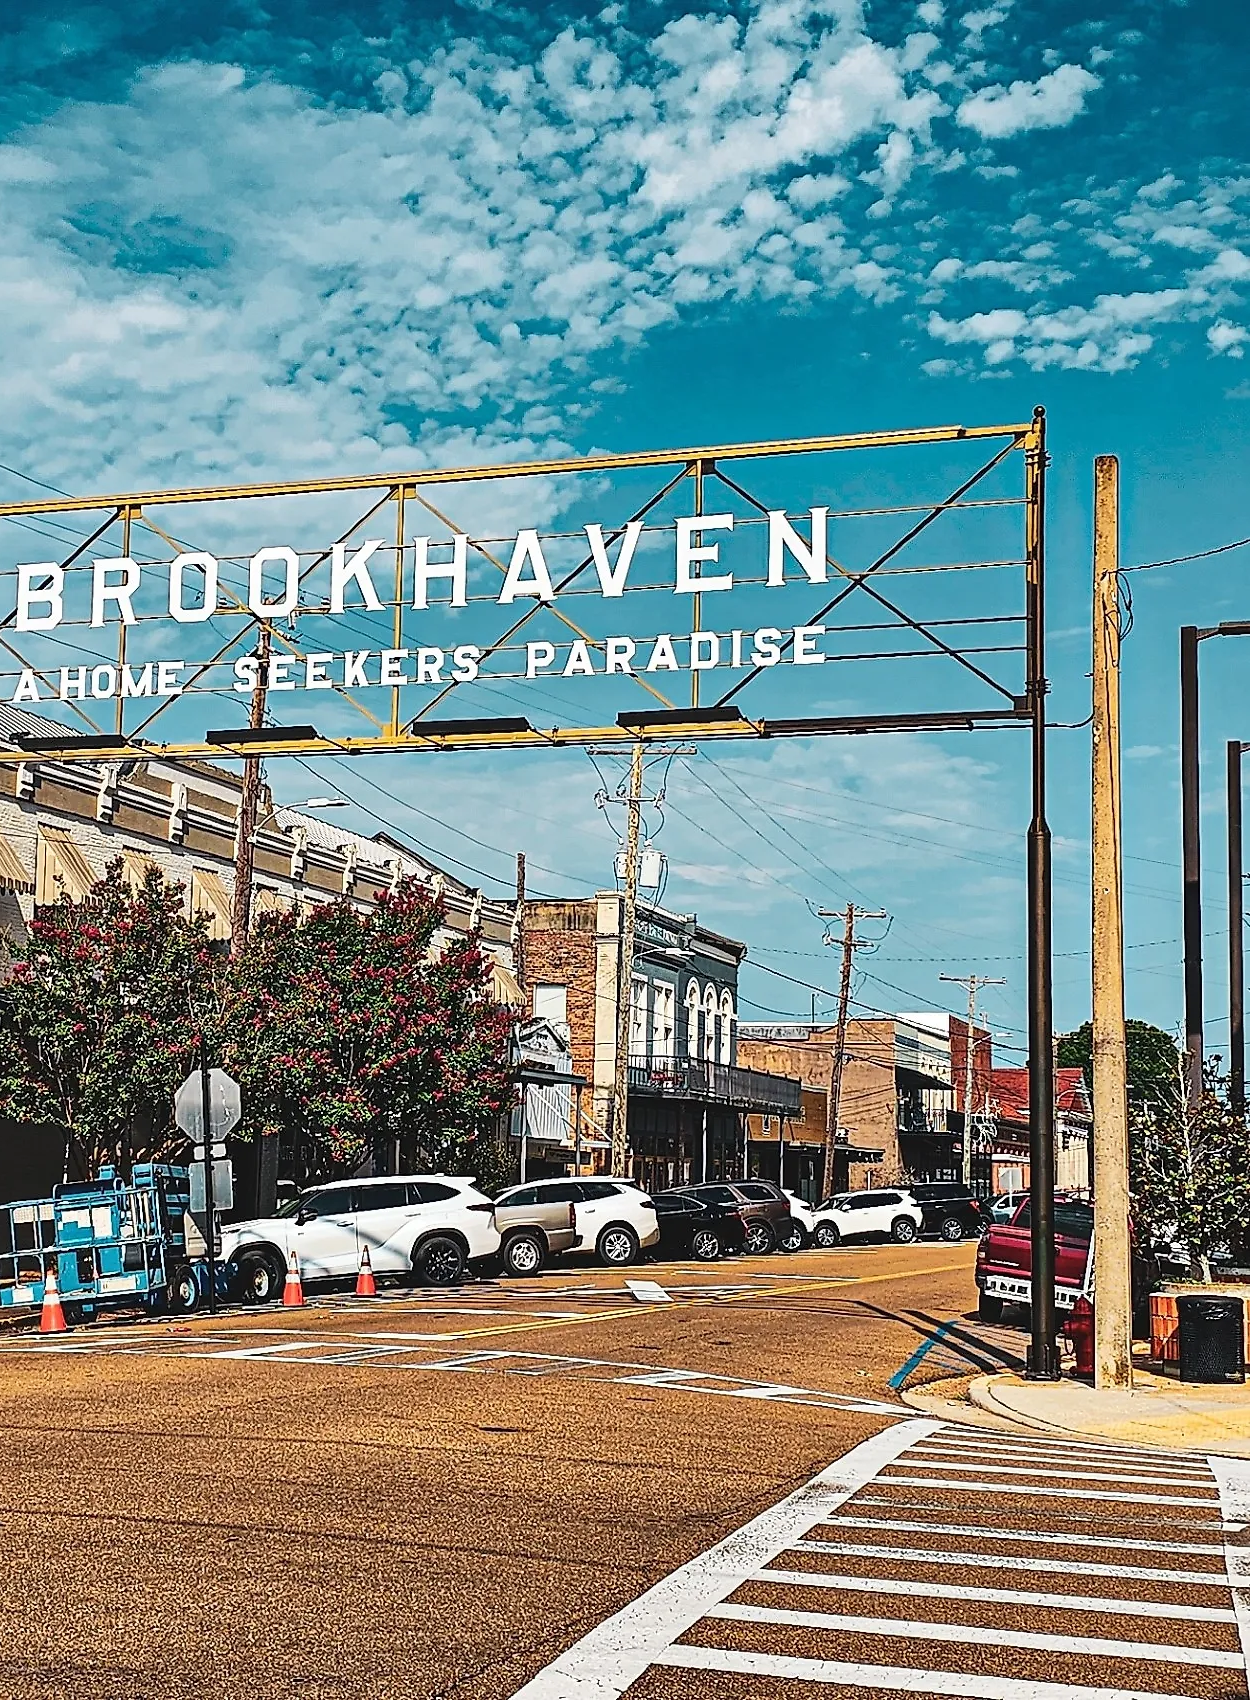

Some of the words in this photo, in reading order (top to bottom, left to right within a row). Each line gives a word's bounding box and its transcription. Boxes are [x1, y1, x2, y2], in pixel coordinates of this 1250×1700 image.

[16, 506, 830, 632] BROOKHAVEN
[12, 667, 41, 703] A
[58, 660, 186, 702] HOME
[232, 643, 482, 694] SEEKERS
[524, 625, 828, 680] PARADISE
